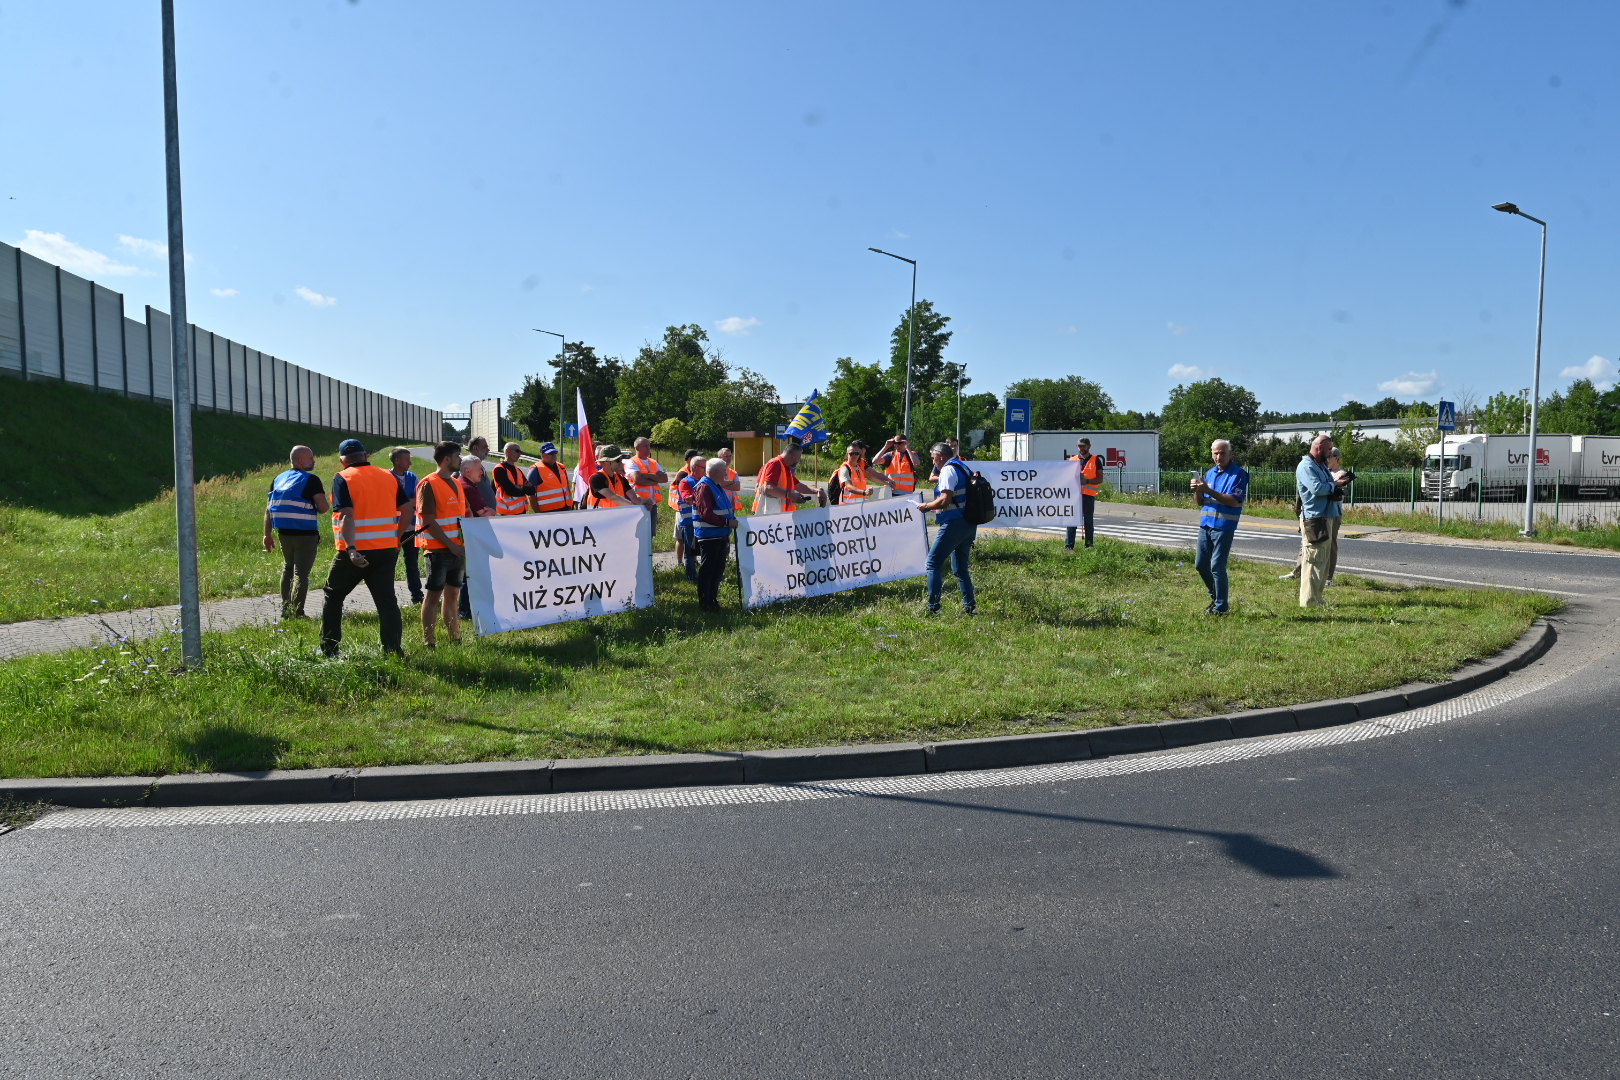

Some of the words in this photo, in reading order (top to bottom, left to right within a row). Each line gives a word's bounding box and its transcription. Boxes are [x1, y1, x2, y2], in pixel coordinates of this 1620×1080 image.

[1000, 470, 1037, 481] STOP
[991, 487, 1071, 499] CEDEROWI
[993, 505, 1034, 517] JANIA
[1037, 505, 1074, 517] KOLEI
[528, 525, 597, 549] WOLĄ
[745, 522, 784, 547] DOŚĆ
[786, 507, 913, 541] FAWORYZOWANIA
[787, 535, 877, 565] TRANSPORTU
[523, 553, 606, 580] SPALINY
[786, 558, 882, 590] DROGOWEGO
[512, 585, 548, 612] NIŻ
[552, 580, 616, 606] SZYNY
